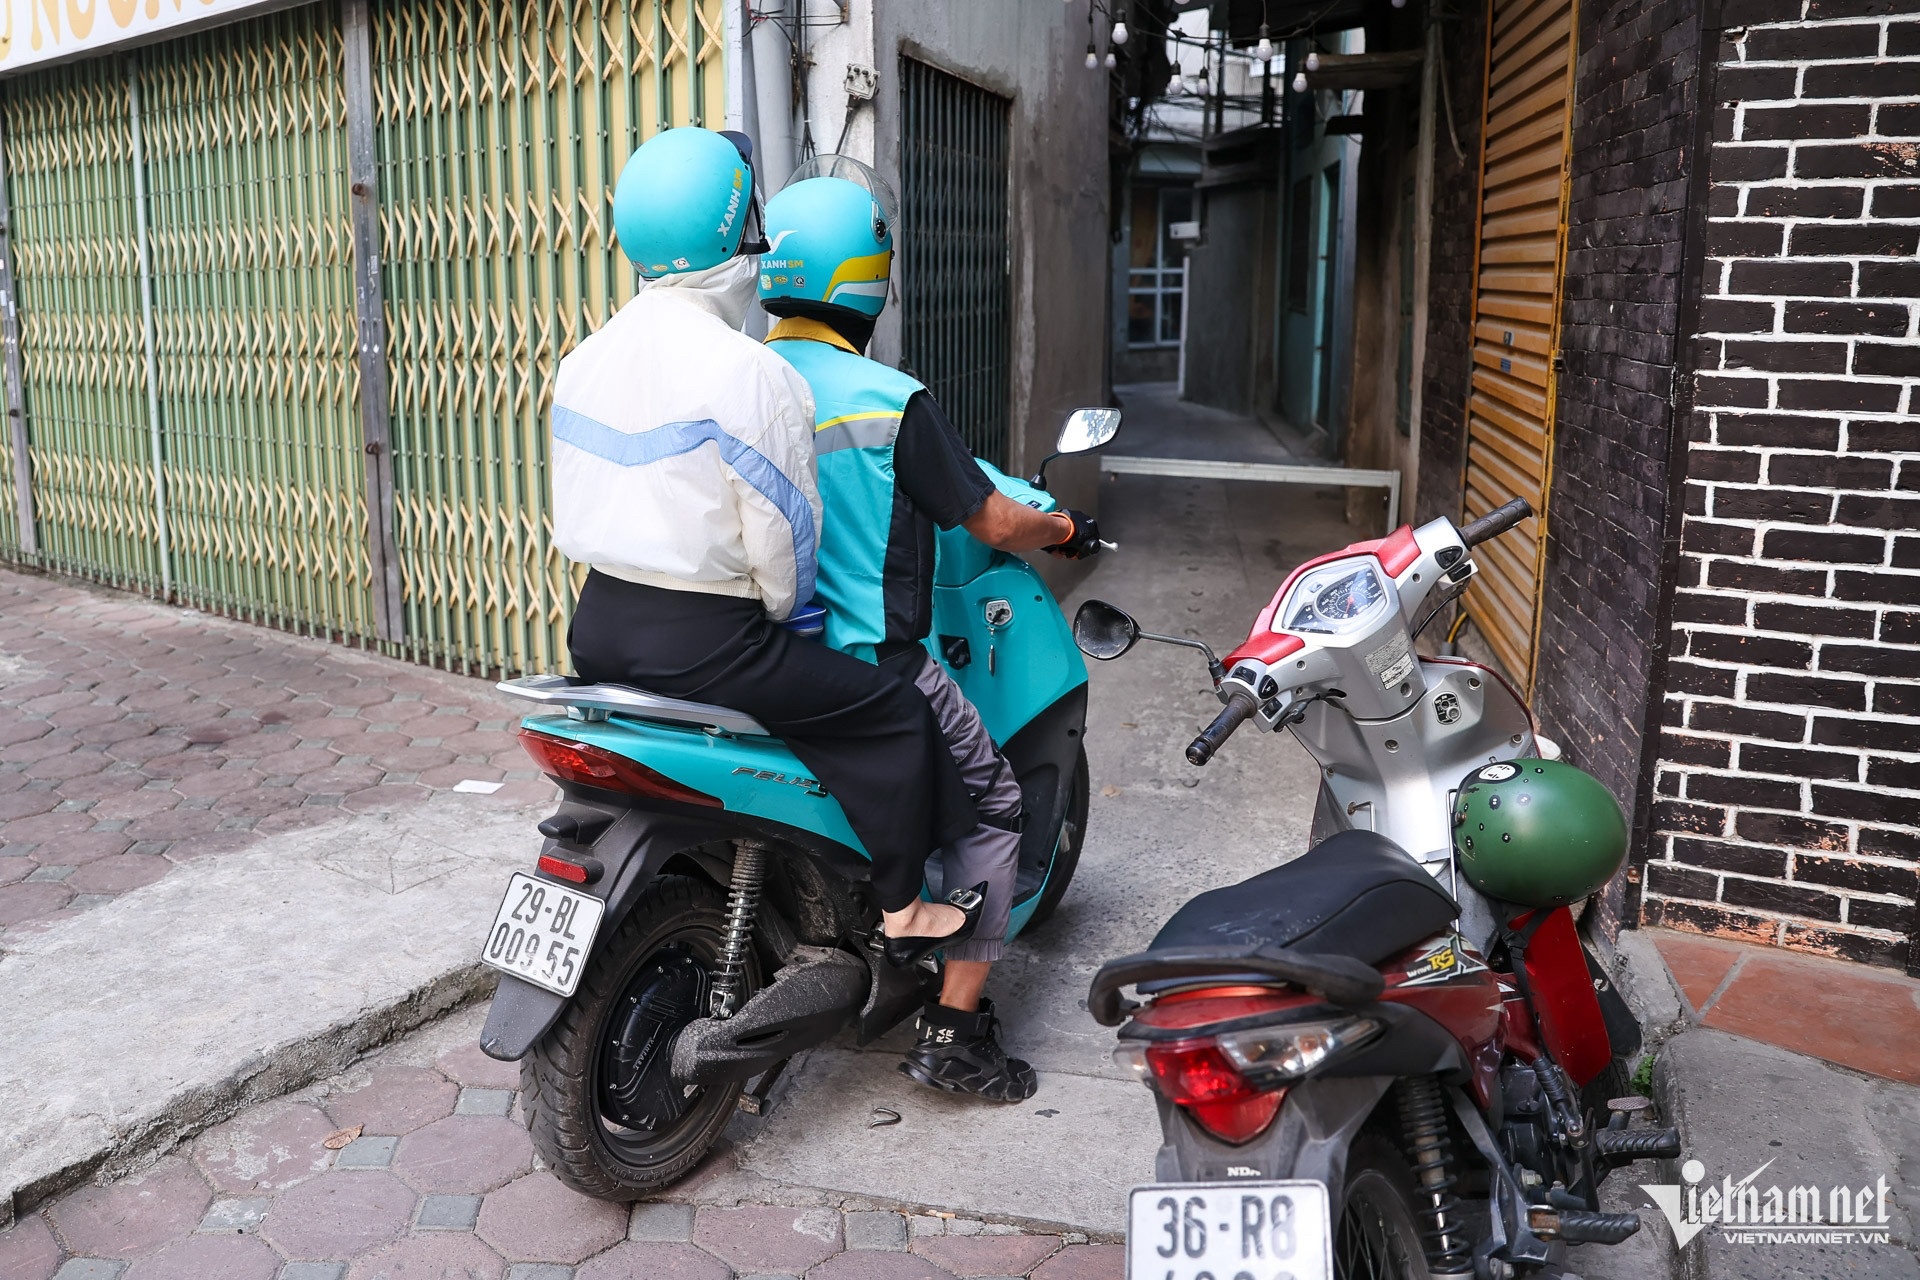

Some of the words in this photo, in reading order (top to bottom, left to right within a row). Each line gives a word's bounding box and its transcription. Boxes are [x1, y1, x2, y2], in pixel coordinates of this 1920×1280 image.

[717, 188, 741, 237] XANH
[733, 168, 743, 189] SM
[761, 260, 787, 269] XANH
[788, 260, 803, 268] SM
[731, 766, 819, 789] FELIZ
[511, 882, 580, 940] 29-BL
[489, 922, 580, 988] 009.55
[1426, 948, 1455, 971] RS
[1156, 1195, 1297, 1259] 36-R8
